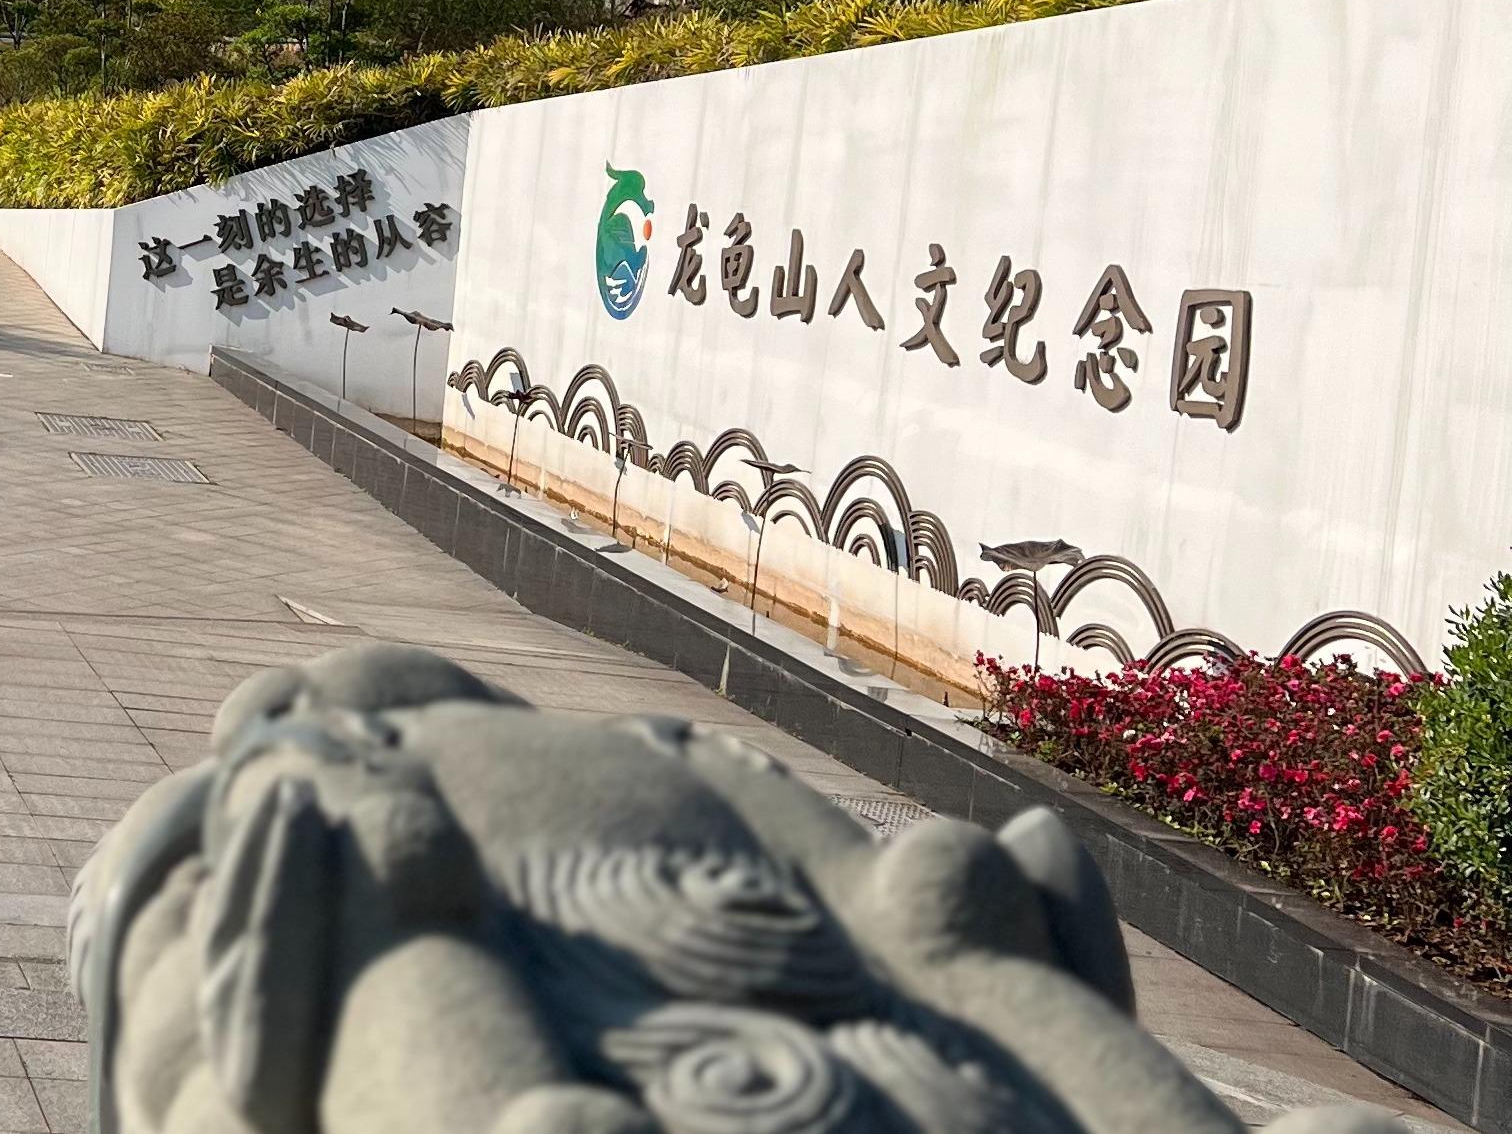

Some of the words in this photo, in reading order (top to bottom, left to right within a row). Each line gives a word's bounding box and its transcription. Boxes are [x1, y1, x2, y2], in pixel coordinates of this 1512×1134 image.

[138, 168, 375, 281] 这一刻的选择
[211, 202, 453, 310] 是余生的从容
[668, 203, 1252, 433] 龙龟山人文纪念园
